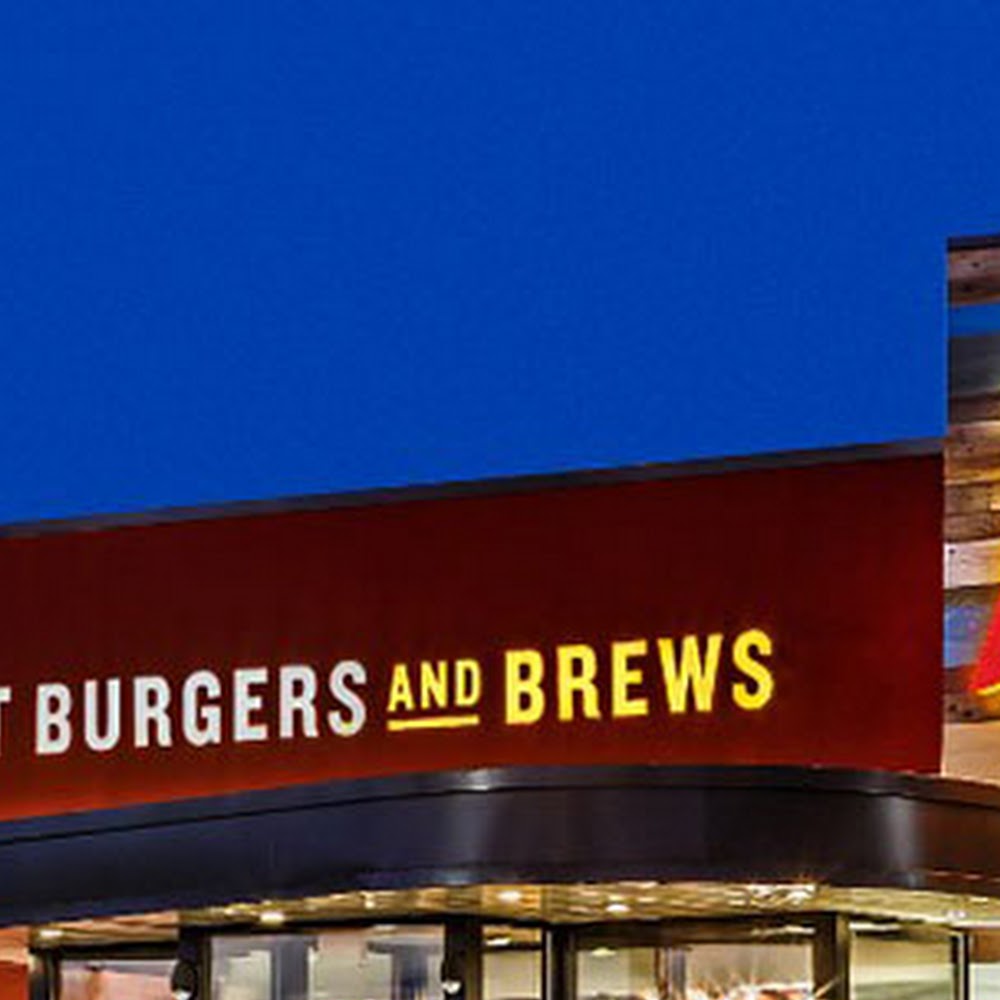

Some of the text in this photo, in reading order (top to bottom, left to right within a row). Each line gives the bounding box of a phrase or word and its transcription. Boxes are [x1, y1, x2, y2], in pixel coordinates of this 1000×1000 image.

[35, 659, 368, 755] BURGERS
[387, 657, 481, 713] AND
[504, 628, 775, 725] BREWS
